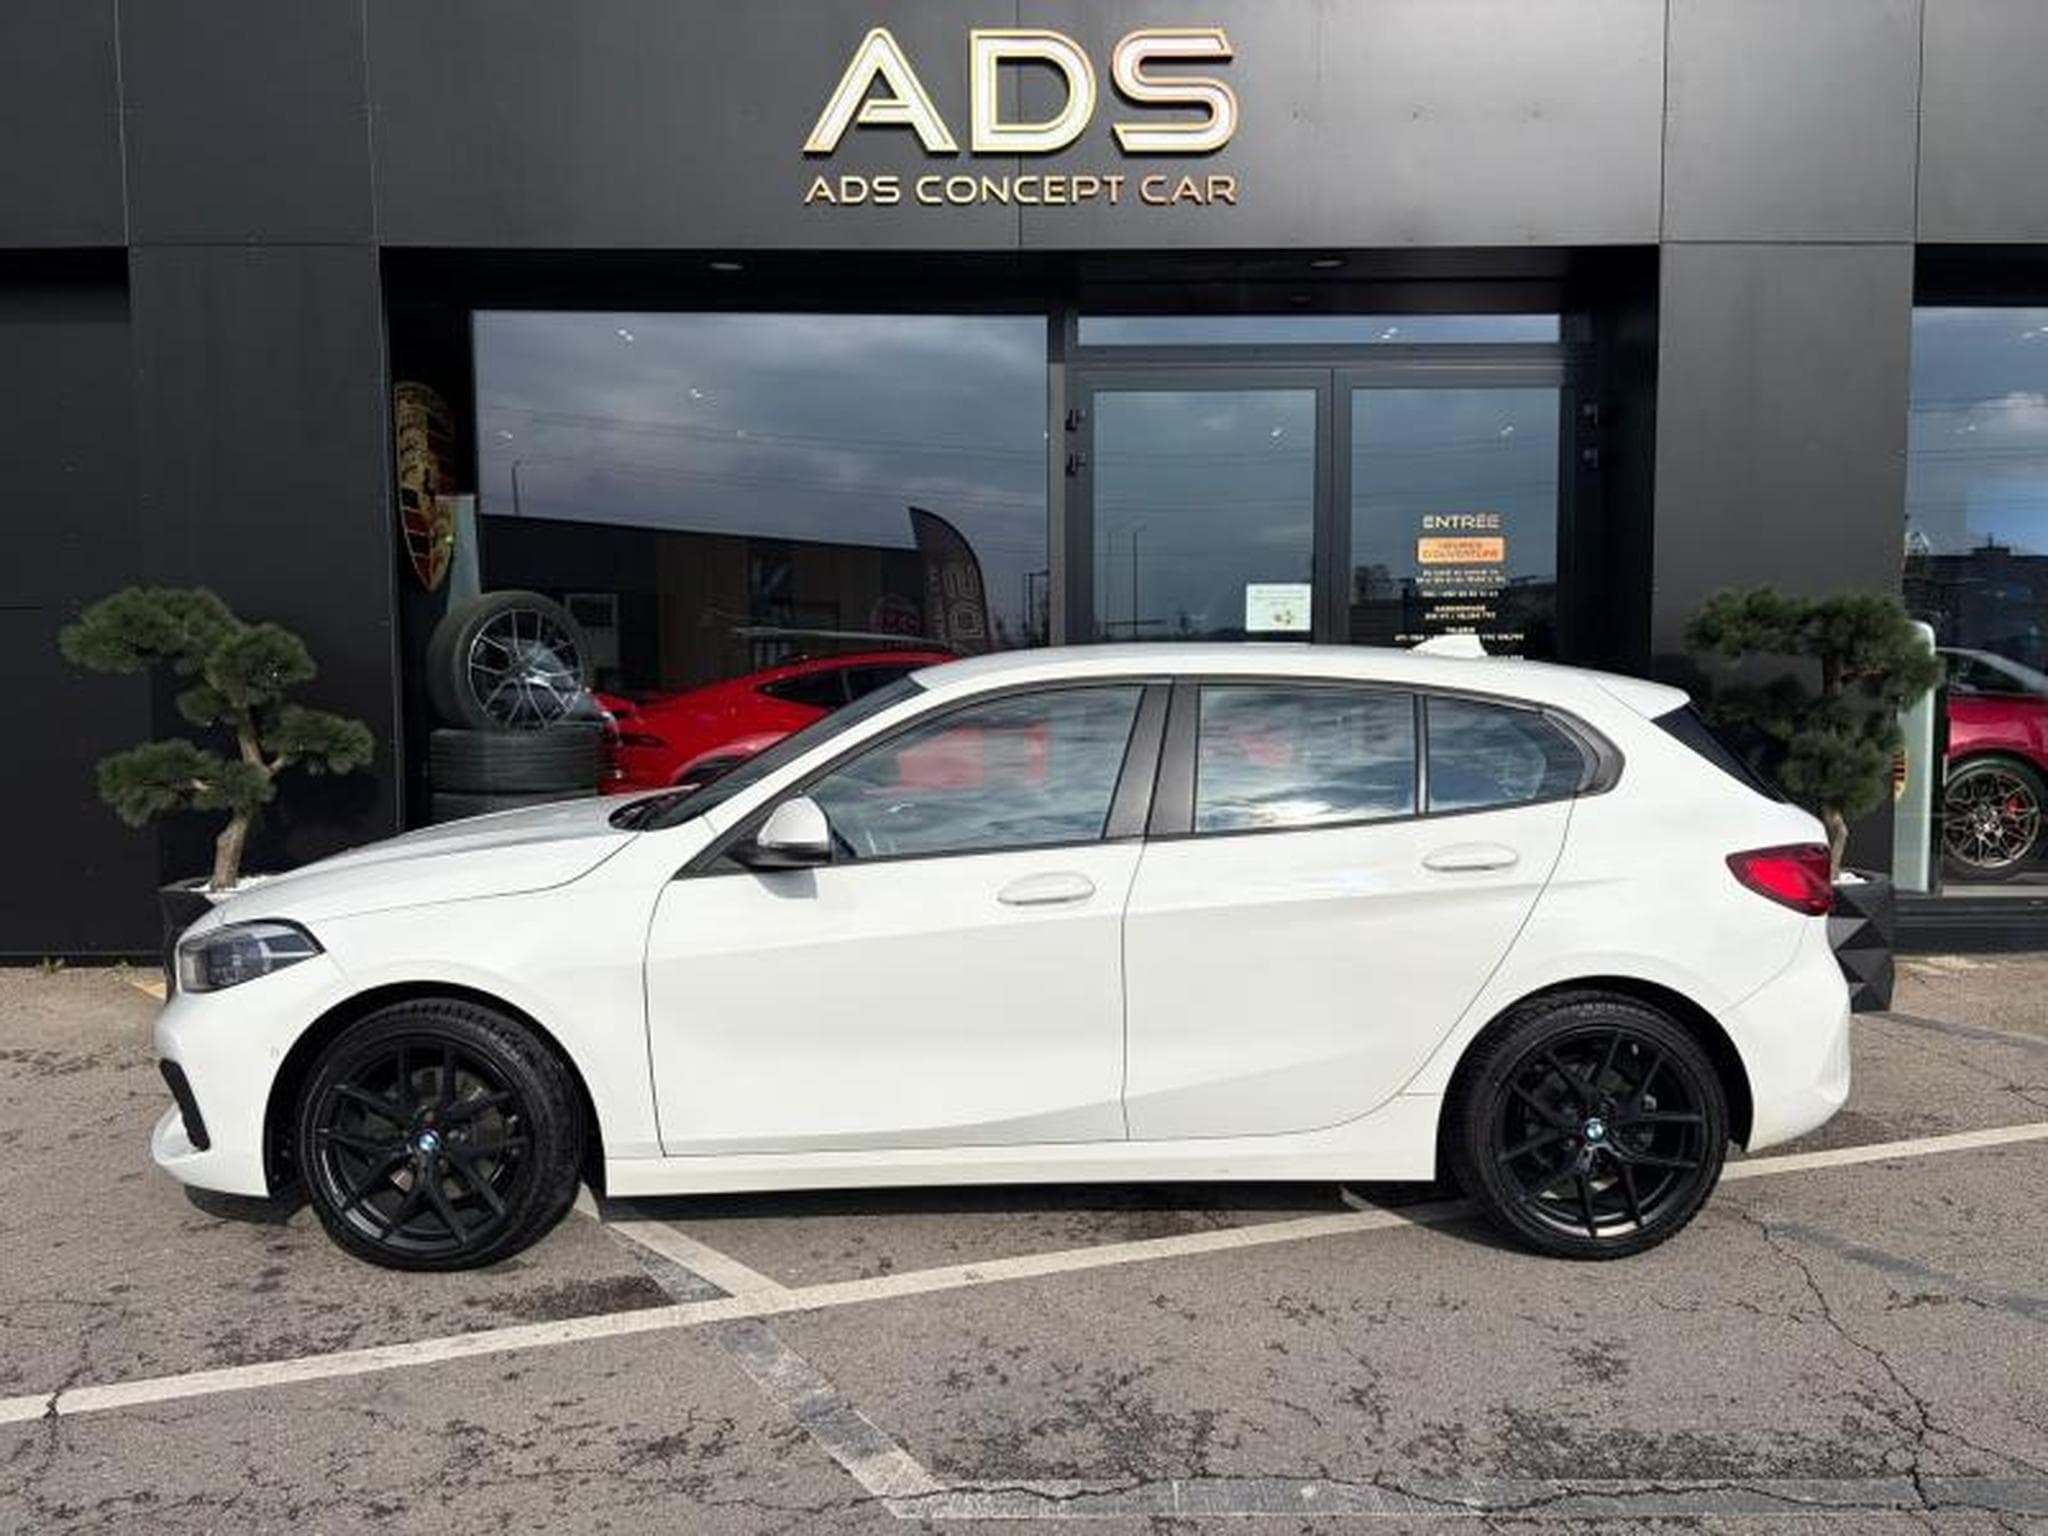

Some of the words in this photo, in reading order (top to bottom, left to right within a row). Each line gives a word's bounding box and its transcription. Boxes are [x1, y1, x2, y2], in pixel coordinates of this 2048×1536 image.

[803, 27, 1238, 153] ADS
[804, 175, 901, 205] ADS
[916, 175, 1125, 205] CONCEPT
[1139, 175, 1237, 205] CAR
